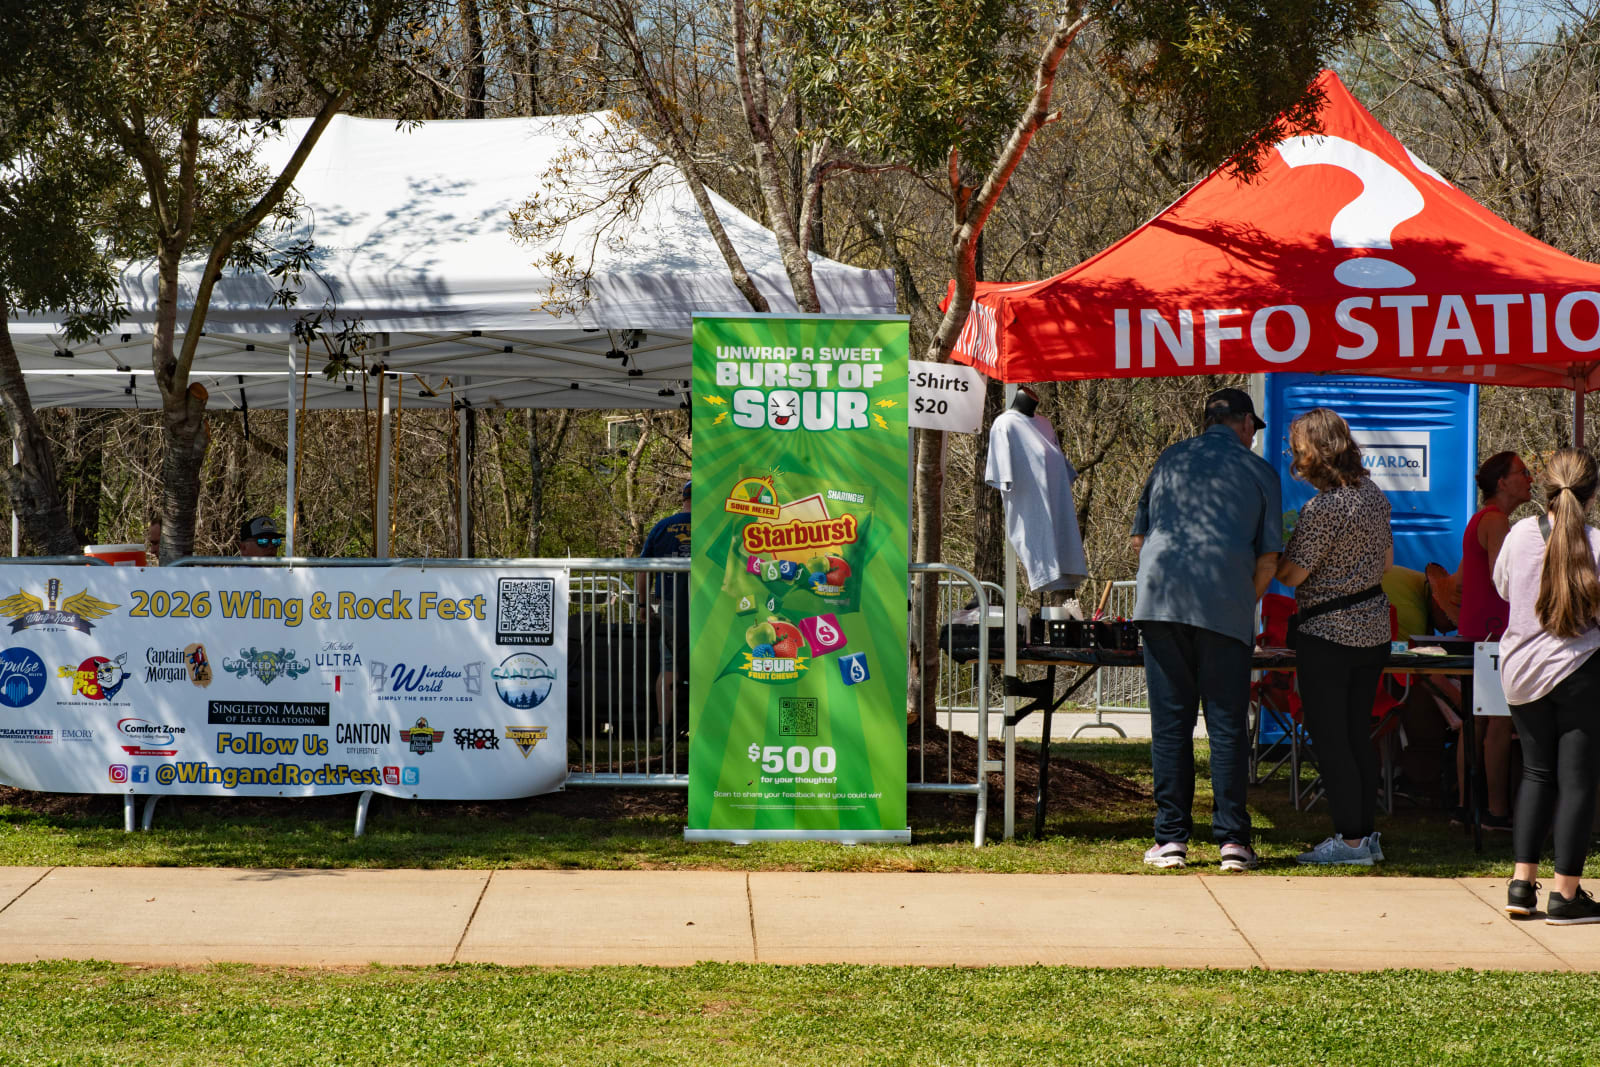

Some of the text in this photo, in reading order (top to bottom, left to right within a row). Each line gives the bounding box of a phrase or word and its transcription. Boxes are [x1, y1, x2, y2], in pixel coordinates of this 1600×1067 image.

[1115, 291, 1600, 369] INFO STATIO
[716, 346, 883, 361] UNWRAP A SWEET
[716, 362, 883, 388] BURST OF
[909, 371, 969, 392] -Shirts
[732, 389, 870, 431] SOUR
[914, 396, 948, 415] $20
[827, 489, 857, 503] SHARING
[730, 502, 775, 515] SOUR METER
[747, 516, 854, 551] Starburst
[129, 590, 487, 627] 2026 Wing & Rock Fest
[500, 636, 533, 644] FESTIVAL
[146, 647, 185, 666] Captain
[315, 653, 362, 667] ULTRA
[231, 661, 303, 670] WICKED WEED
[752, 659, 795, 673] SOUR
[145, 666, 187, 683] Morgan
[391, 663, 462, 692] Window
[490, 667, 558, 681] CANTON
[748, 671, 798, 680] FRUIT CHEWS
[212, 703, 327, 716] SINGLETON MARINE
[225, 715, 236, 723] OF
[265, 716, 316, 724] ALLATOONA
[61, 730, 94, 738] EMORY
[125, 724, 186, 734] Comfort Zone
[336, 723, 390, 745] CANTON
[453, 728, 495, 740] SCHOOL
[217, 732, 328, 755] Follow Us
[748, 743, 836, 774] $500
[156, 762, 382, 789] @WingandRockFest
[795, 776, 837, 785] thoughts?
[713, 790, 731, 798] Scan
[782, 791, 816, 799] feedback
